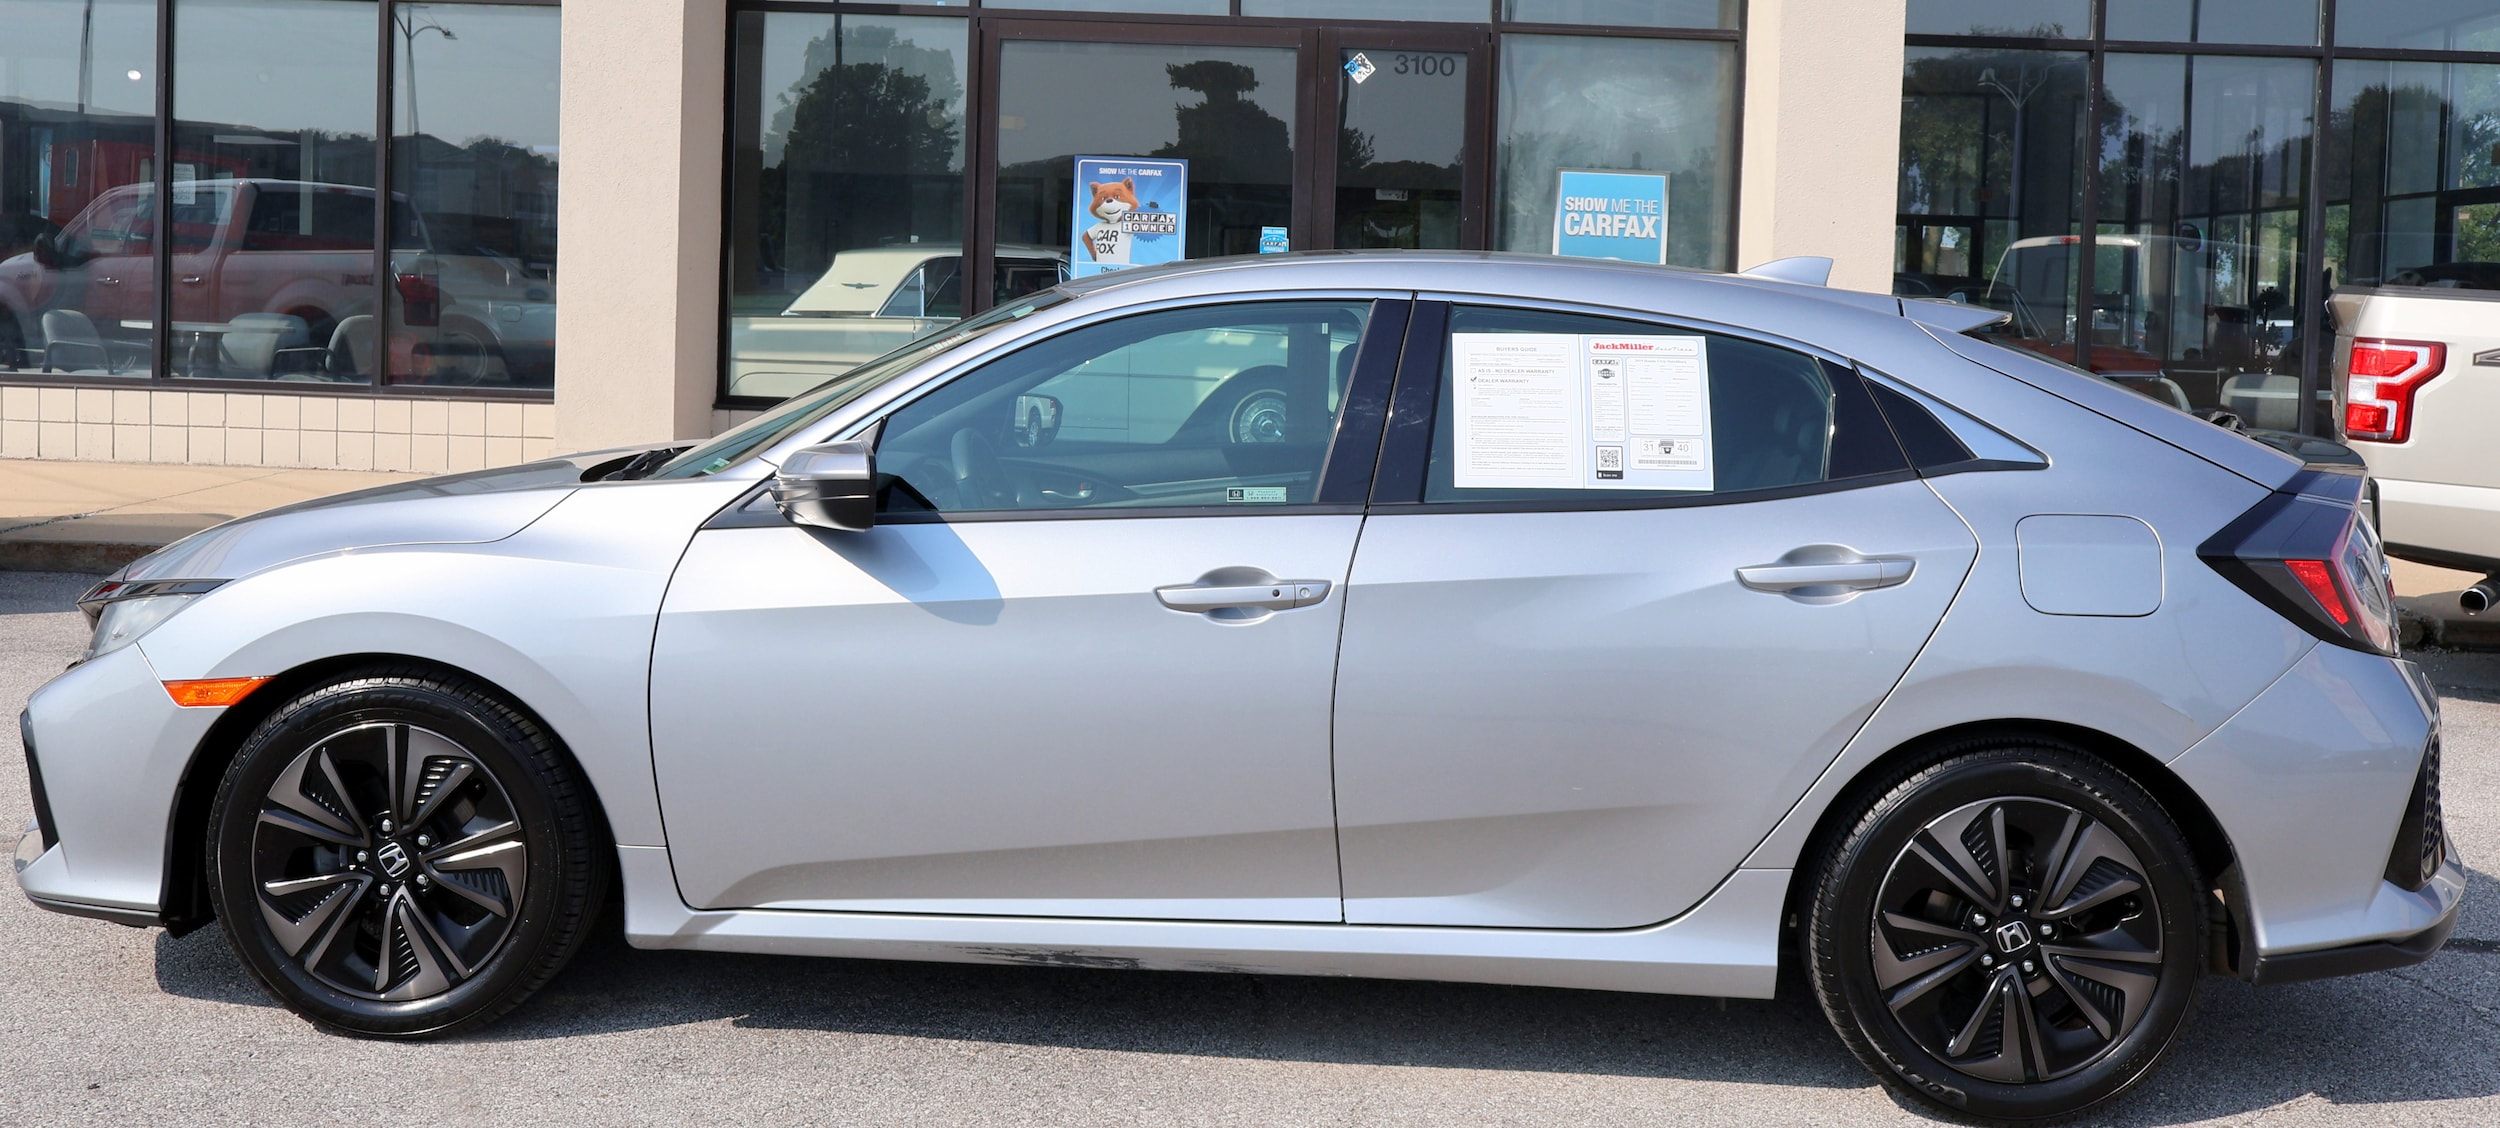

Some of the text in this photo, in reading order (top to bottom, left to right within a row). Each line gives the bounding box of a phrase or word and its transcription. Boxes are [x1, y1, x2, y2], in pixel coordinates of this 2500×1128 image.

[1394, 54, 1456, 77] 3100
[1128, 168, 1138, 176] THE
[1138, 169, 1163, 177] CARFAX
[1564, 196, 1659, 214] SHOW ME THE
[1124, 213, 1175, 224] CARFAX
[1132, 223, 1175, 233] OWNER
[1564, 212, 1658, 239] CARFAX
[1096, 229, 1119, 243] CAR
[1643, 443, 1689, 452] 31 40
